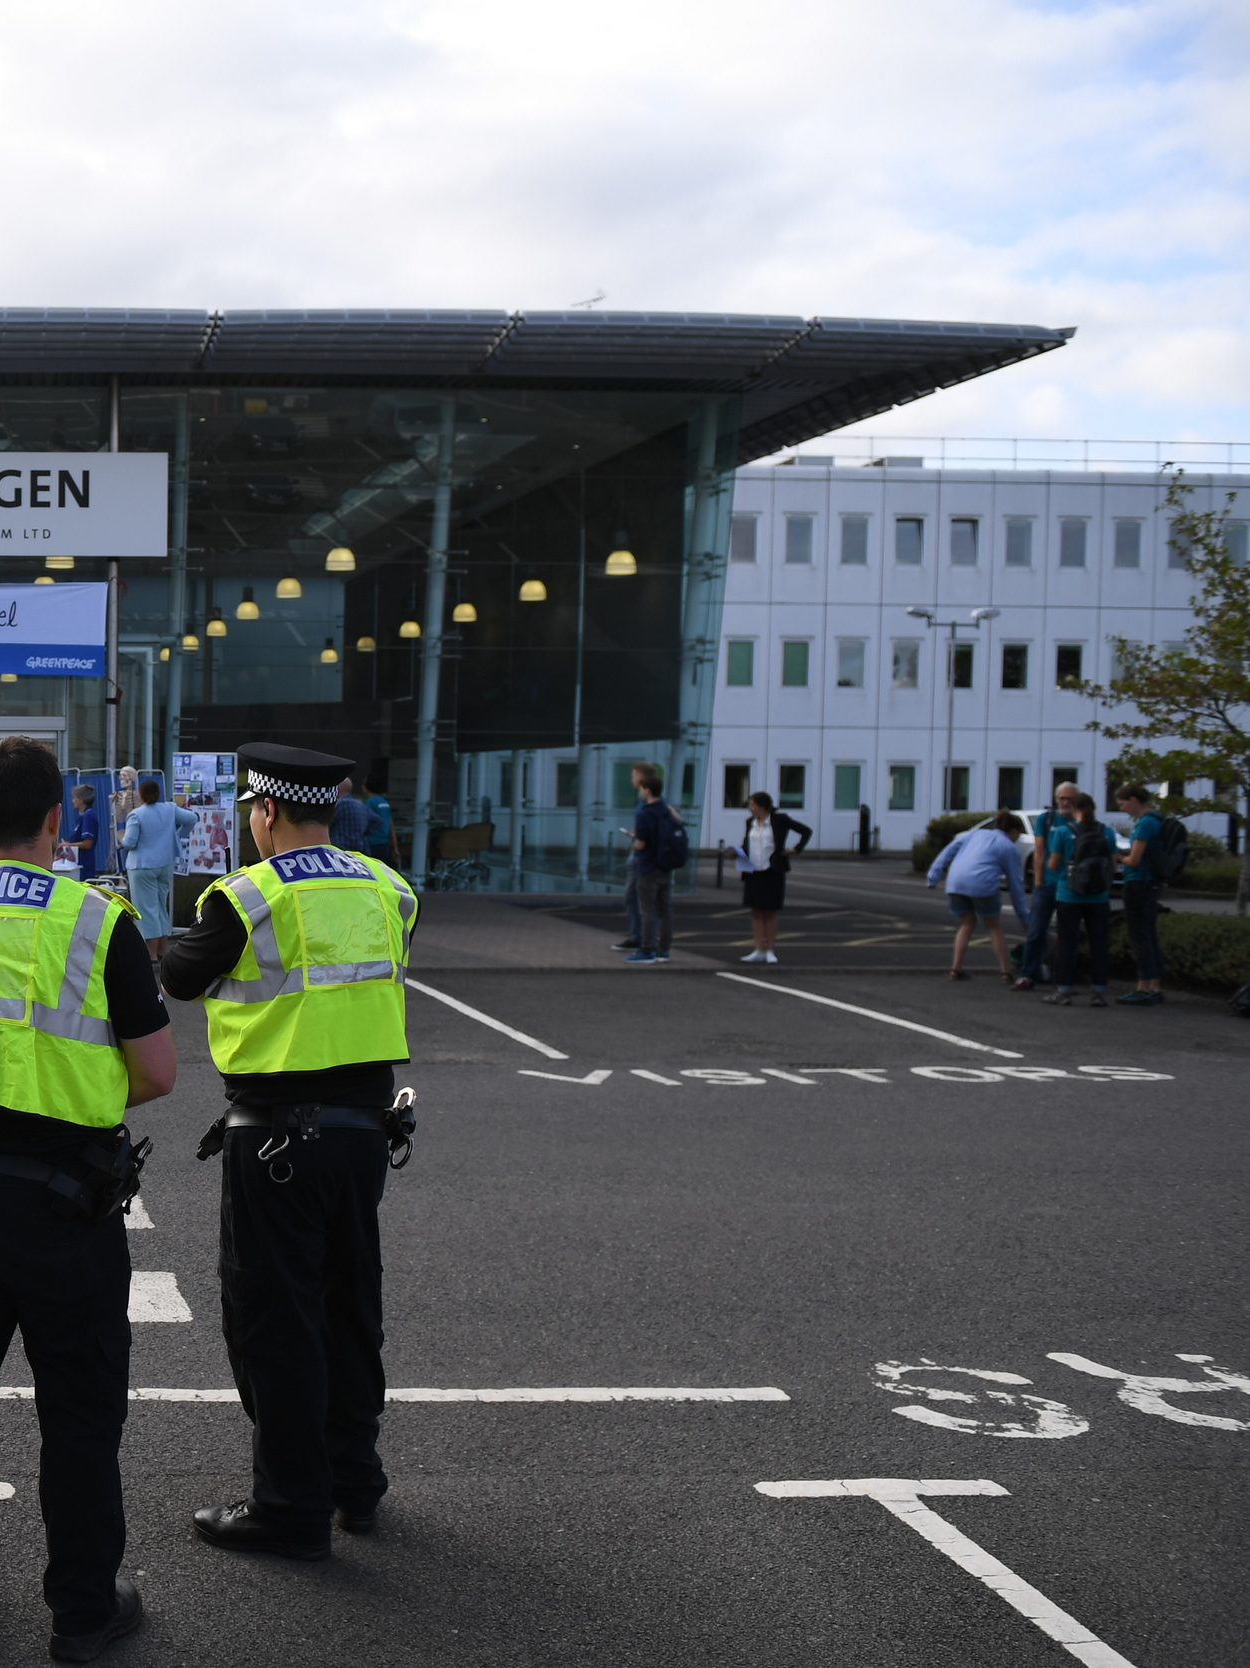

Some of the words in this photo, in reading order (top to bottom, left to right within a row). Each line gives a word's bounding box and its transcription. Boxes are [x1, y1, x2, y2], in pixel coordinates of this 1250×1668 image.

[23, 528, 52, 539] LTD
[25, 655, 97, 669] GREENPEACE
[276, 851, 370, 878] POLICE
[517, 1063, 1176, 1086] VISITORS
